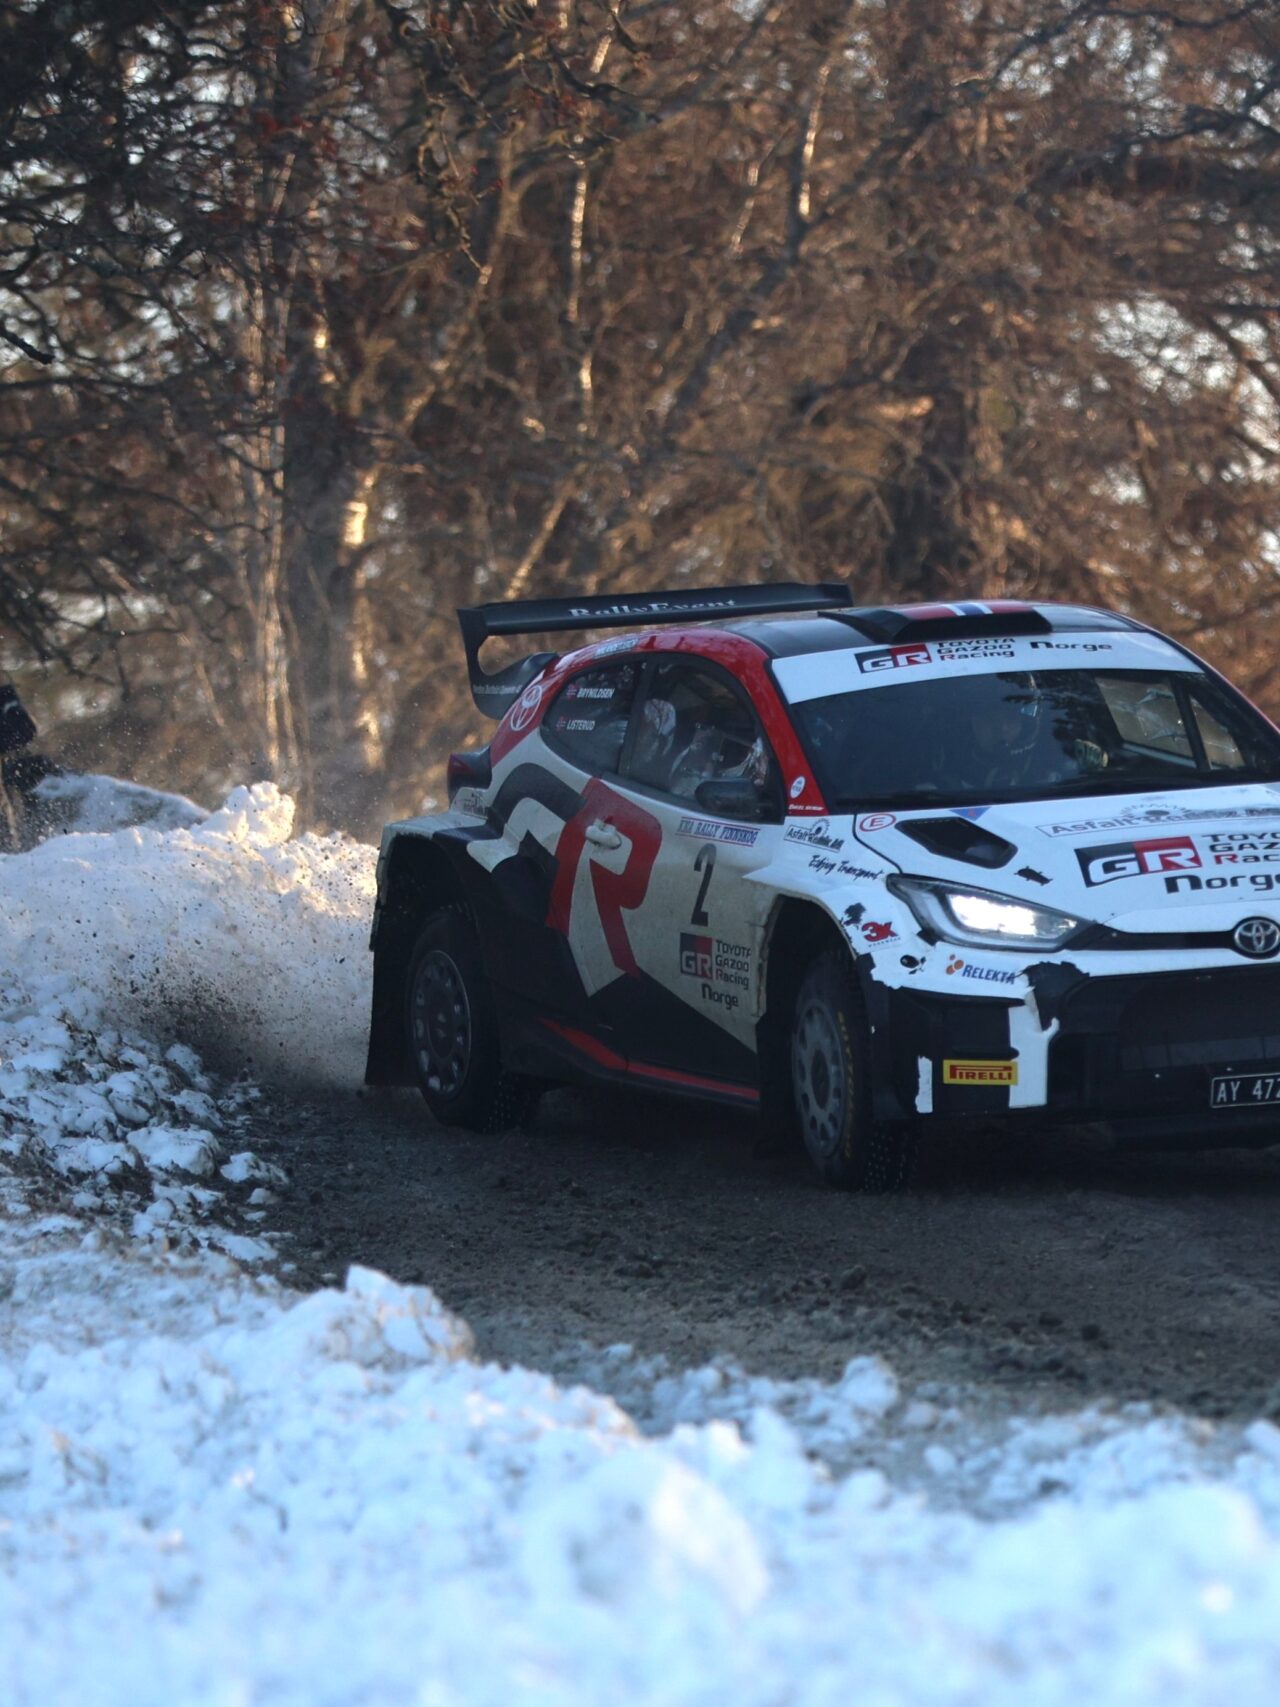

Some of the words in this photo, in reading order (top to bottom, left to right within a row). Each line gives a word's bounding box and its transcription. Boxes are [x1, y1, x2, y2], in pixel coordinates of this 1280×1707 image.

[937, 644, 1012, 654] GAZOO
[938, 638, 1016, 648] TOYOTA
[859, 649, 931, 673] GR
[939, 651, 1015, 661] Racing
[1052, 814, 1135, 834] Asfalt
[1083, 844, 1202, 886] GR
[690, 843, 717, 927] 2
[681, 946, 712, 978] GR
[715, 955, 749, 972] GAZOO
[716, 968, 749, 990] Racing
[961, 964, 1016, 985] RELEKTA
[701, 983, 739, 1010] Norge
[949, 1064, 1013, 1080] PIRELLI
[1216, 1080, 1240, 1102] AY
